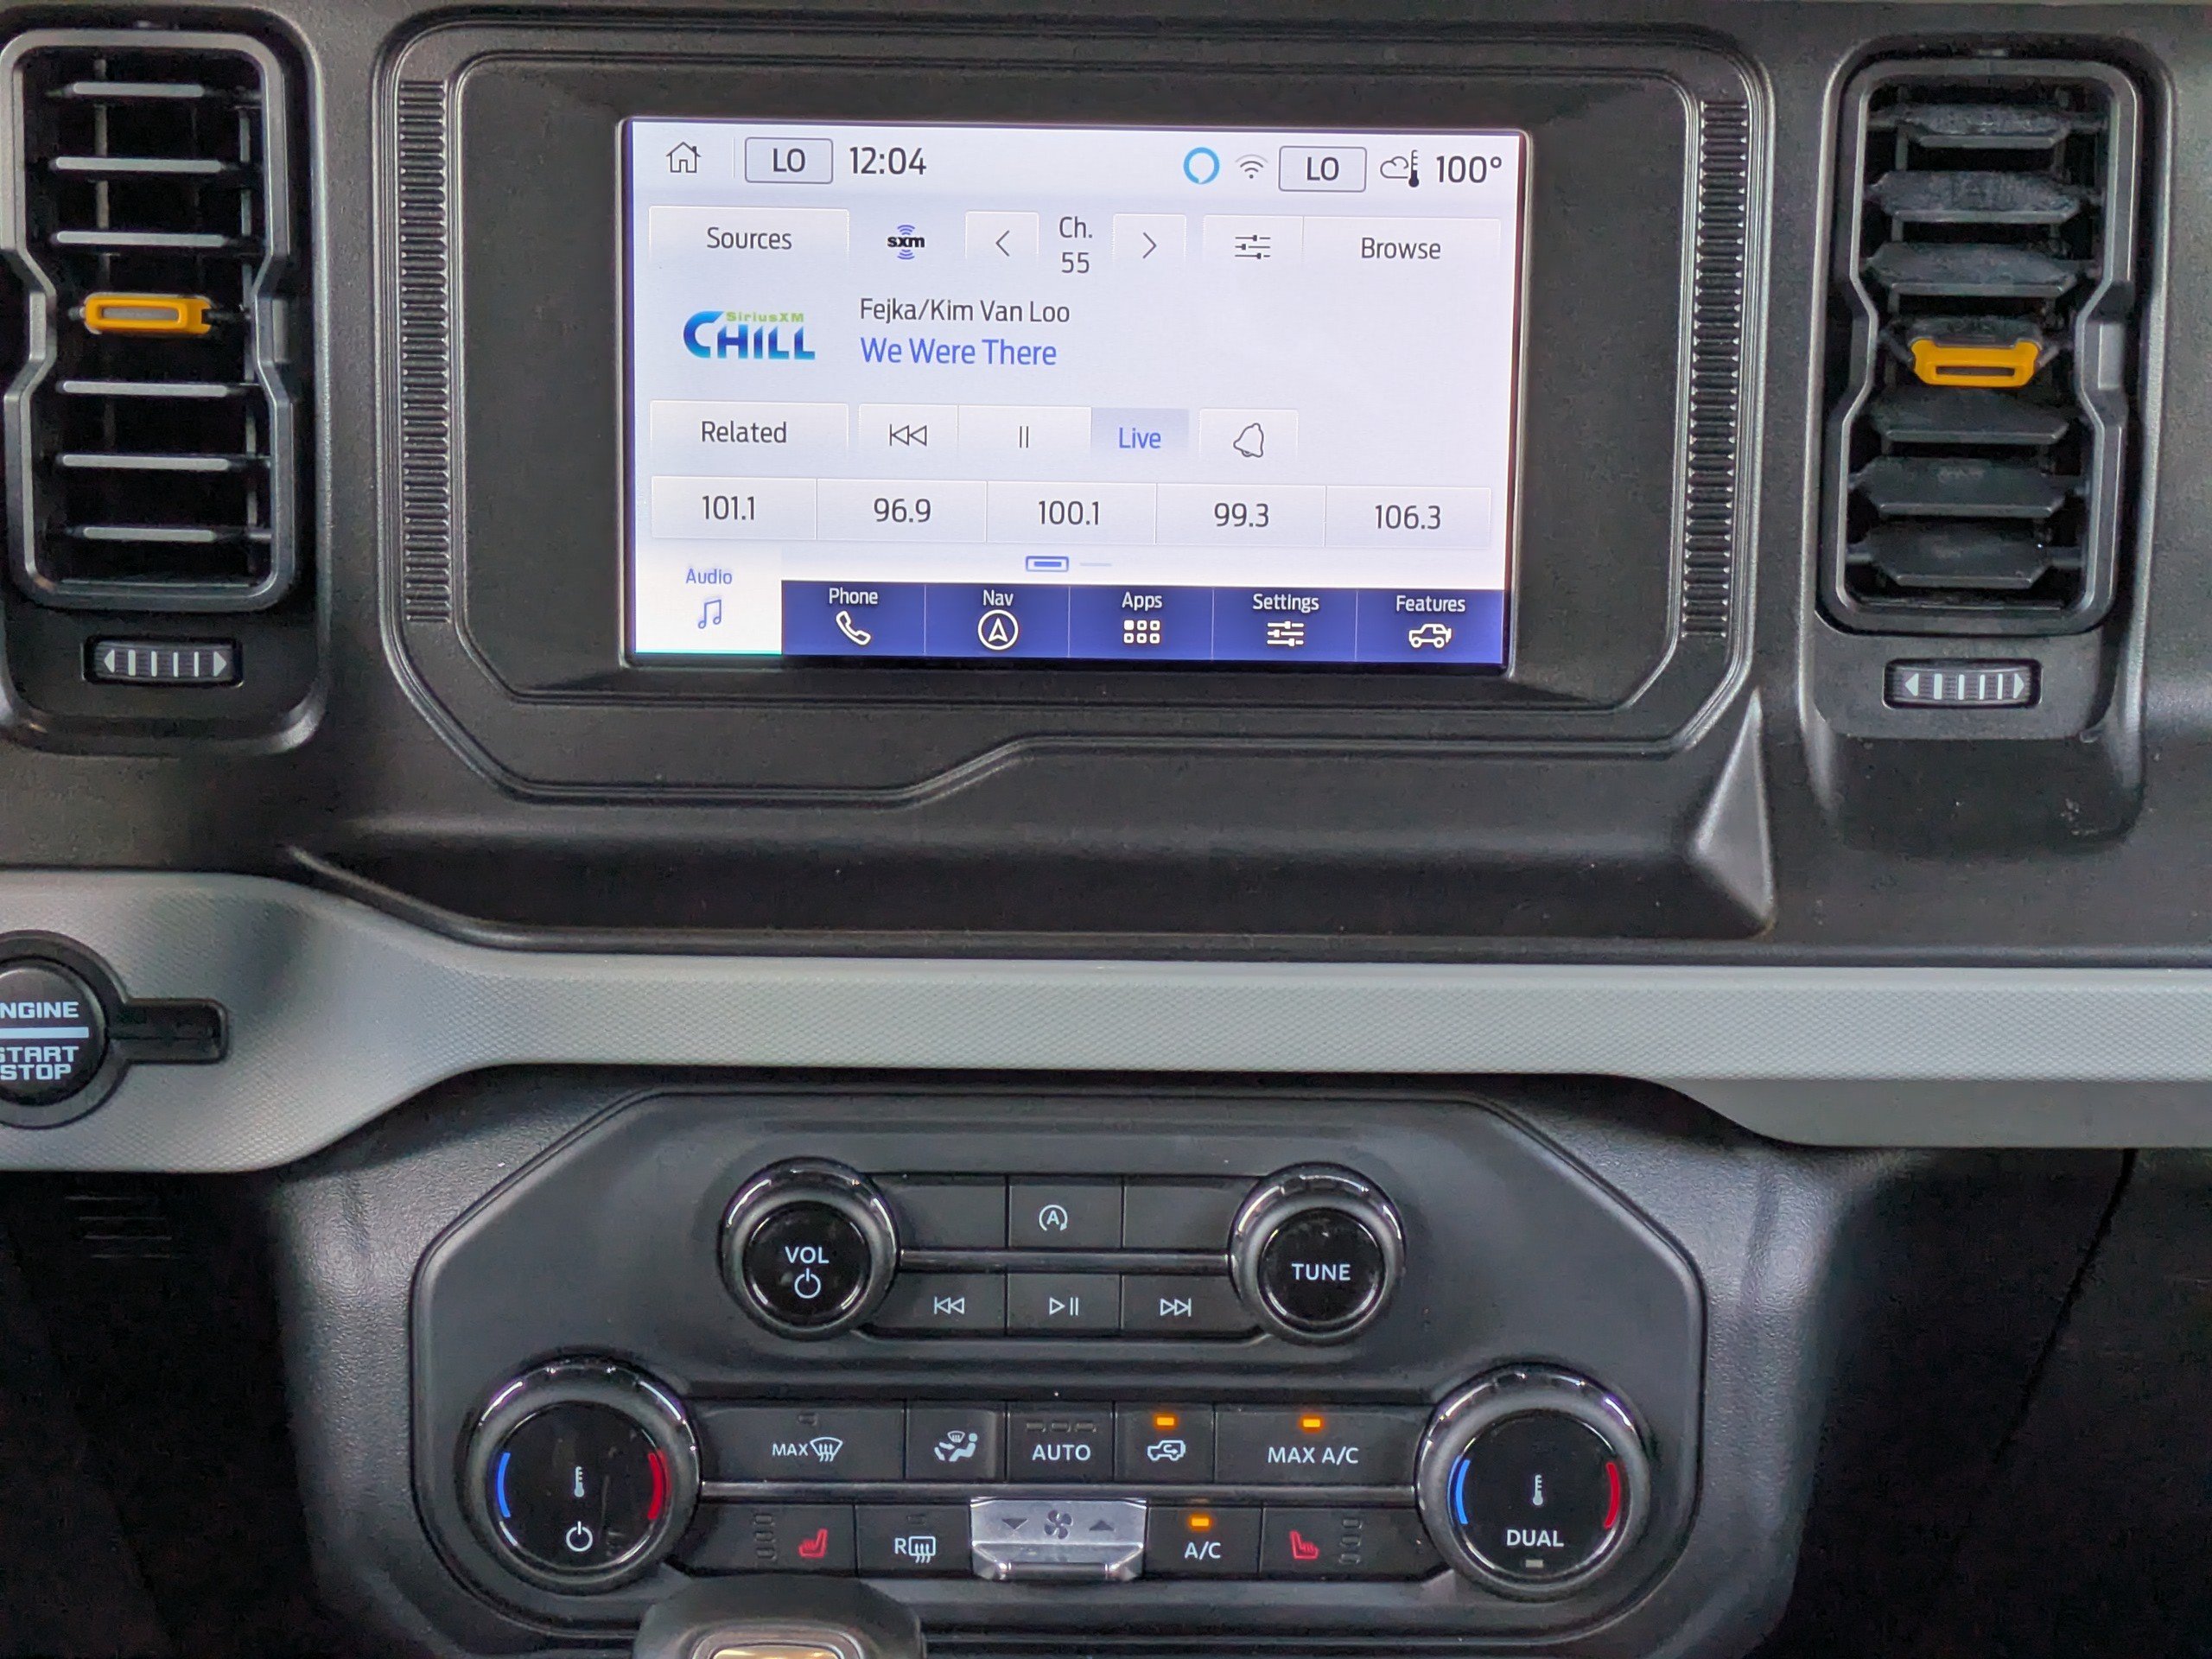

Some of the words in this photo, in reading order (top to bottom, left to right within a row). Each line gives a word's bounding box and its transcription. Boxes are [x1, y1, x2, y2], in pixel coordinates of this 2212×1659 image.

[773, 149, 805, 172] LO
[850, 147, 926, 175] 12:04
[1307, 157, 1338, 181] LO
[1437, 156, 1502, 183] 100°
[1059, 216, 1092, 238] Ch.
[707, 227, 791, 250] Sources
[887, 236, 925, 249] sxm
[1362, 238, 1440, 259] Browse
[1062, 252, 1089, 273] 55
[727, 312, 804, 323] SiriusXM
[861, 298, 973, 323] Fejka/Kim
[981, 300, 1022, 321] Van
[1030, 302, 1069, 322] Loo
[683, 311, 815, 359] CHILL
[861, 337, 901, 363] We
[909, 338, 976, 364] Were
[982, 339, 1056, 365] There
[702, 421, 786, 442] Related
[1120, 428, 1160, 448] Live
[702, 496, 753, 520] 101.1
[874, 499, 931, 522] 96.9
[1039, 501, 1098, 524] 100.1
[1215, 503, 1268, 527] 99.3
[1376, 505, 1440, 529] 106.3
[686, 569, 732, 584] Audio
[830, 588, 878, 604] Phone
[983, 590, 1014, 606] Nav
[1122, 592, 1162, 611] Apps
[1253, 593, 1319, 613] Settings
[1396, 595, 1465, 612] Features
[0, 1001, 79, 1019] NGINE
[0, 1064, 72, 1081] STOP
[785, 1247, 829, 1263] VOL
[1292, 1263, 1350, 1281] TUNE
[772, 1444, 808, 1456] MAX
[1033, 1445, 1090, 1460] AUTO
[1268, 1447, 1314, 1463] MAX
[1322, 1446, 1358, 1465] A/C
[1507, 1529, 1564, 1547] DUAL
[1185, 1541, 1220, 1560] A/C
